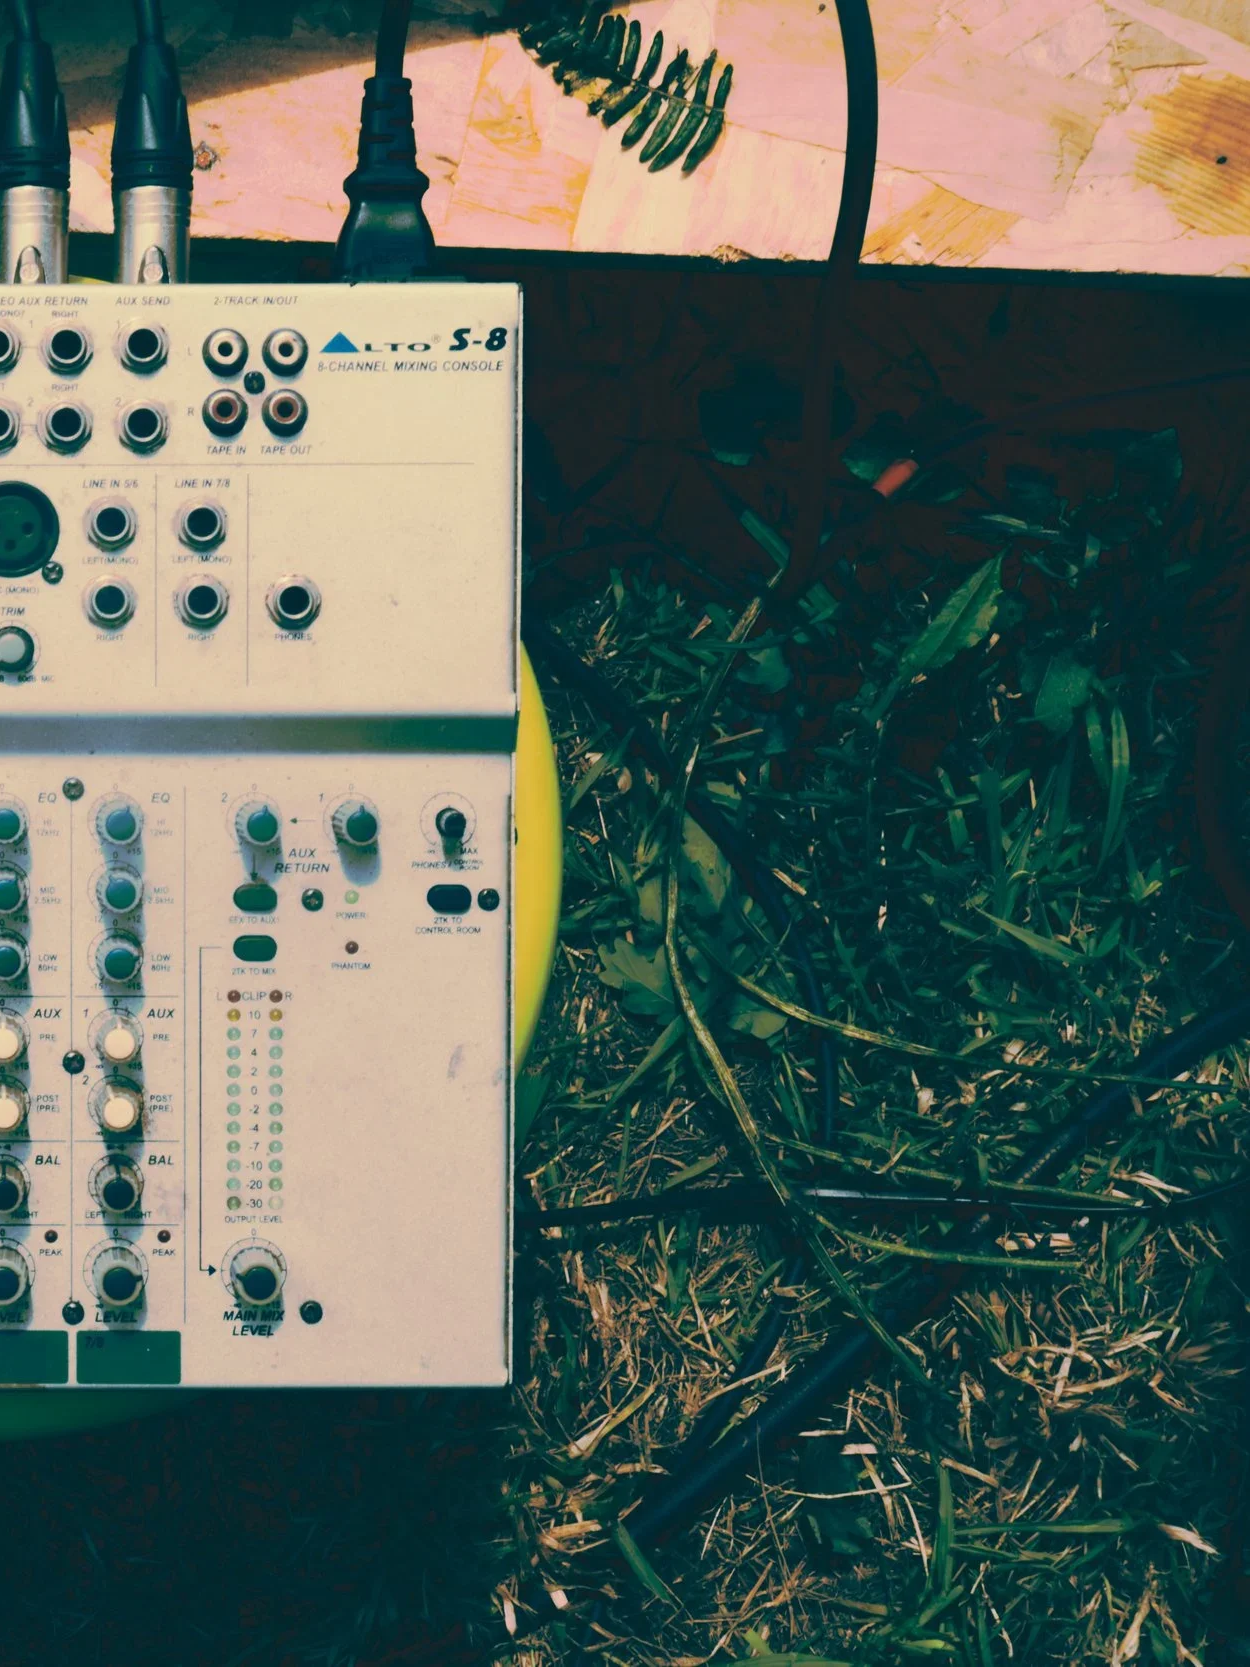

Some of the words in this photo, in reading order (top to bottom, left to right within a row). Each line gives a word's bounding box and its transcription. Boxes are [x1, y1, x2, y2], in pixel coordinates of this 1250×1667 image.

[18, 296, 41, 306] AUX
[44, 296, 89, 306] RETURN
[115, 296, 137, 306] AUX
[142, 296, 170, 305] SEND
[213, 295, 260, 306] 2-TRACK
[262, 295, 298, 305] IN/OUT
[51, 310, 79, 318] RIGHT
[449, 327, 508, 352] S-8
[318, 361, 389, 372] 8-CHANNEL
[394, 361, 438, 372] MIXING
[443, 361, 504, 372] CONSOLE
[51, 384, 79, 392] RIGHT
[206, 445, 233, 456] TAPE
[235, 445, 246, 455] IN
[260, 445, 287, 456] TAPE
[289, 445, 312, 455] OUT
[82, 479, 107, 489] LINE
[110, 479, 121, 489] IN
[174, 479, 198, 489] LINE
[201, 479, 213, 489] IN
[215, 479, 231, 489] 7/8
[0, 606, 26, 617] TRIM
[96, 633, 124, 642] RIGHT
[275, 633, 312, 642] PHONES
[37, 792, 57, 803] EQ
[151, 792, 170, 803] EQ
[288, 848, 316, 859] AUX
[460, 847, 478, 855] MAX
[274, 862, 330, 874] RETURN
[434, 917, 449, 925] 2TK
[451, 916, 462, 924] TO
[415, 927, 456, 935] CONTROL
[331, 962, 371, 970] PHANTOM
[231, 967, 247, 975] 2TK
[249, 967, 260, 975] TO
[242, 992, 266, 1001] CLIP
[33, 1009, 62, 1018] AUX
[147, 1009, 175, 1018] AUX
[249, 1011, 261, 1020] 10
[39, 1033, 57, 1041] PRE
[153, 1033, 170, 1041] PRE
[34, 1155, 61, 1165] BAL
[148, 1155, 174, 1165] BAL
[246, 1161, 263, 1170] -10
[246, 1180, 263, 1189] -20
[246, 1199, 263, 1208] -30
[11, 1211, 39, 1219] RIGHT
[85, 1210, 107, 1219] LEFT
[124, 1210, 152, 1219] RIGHT
[224, 1216, 257, 1224] OUTPUT
[260, 1216, 283, 1224] LEVEL
[152, 1248, 176, 1256] PEAK
[95, 1312, 138, 1323] LEVEL
[223, 1311, 257, 1321] MAIN
[260, 1311, 285, 1321] MIX
[232, 1325, 274, 1336] LEVEL
